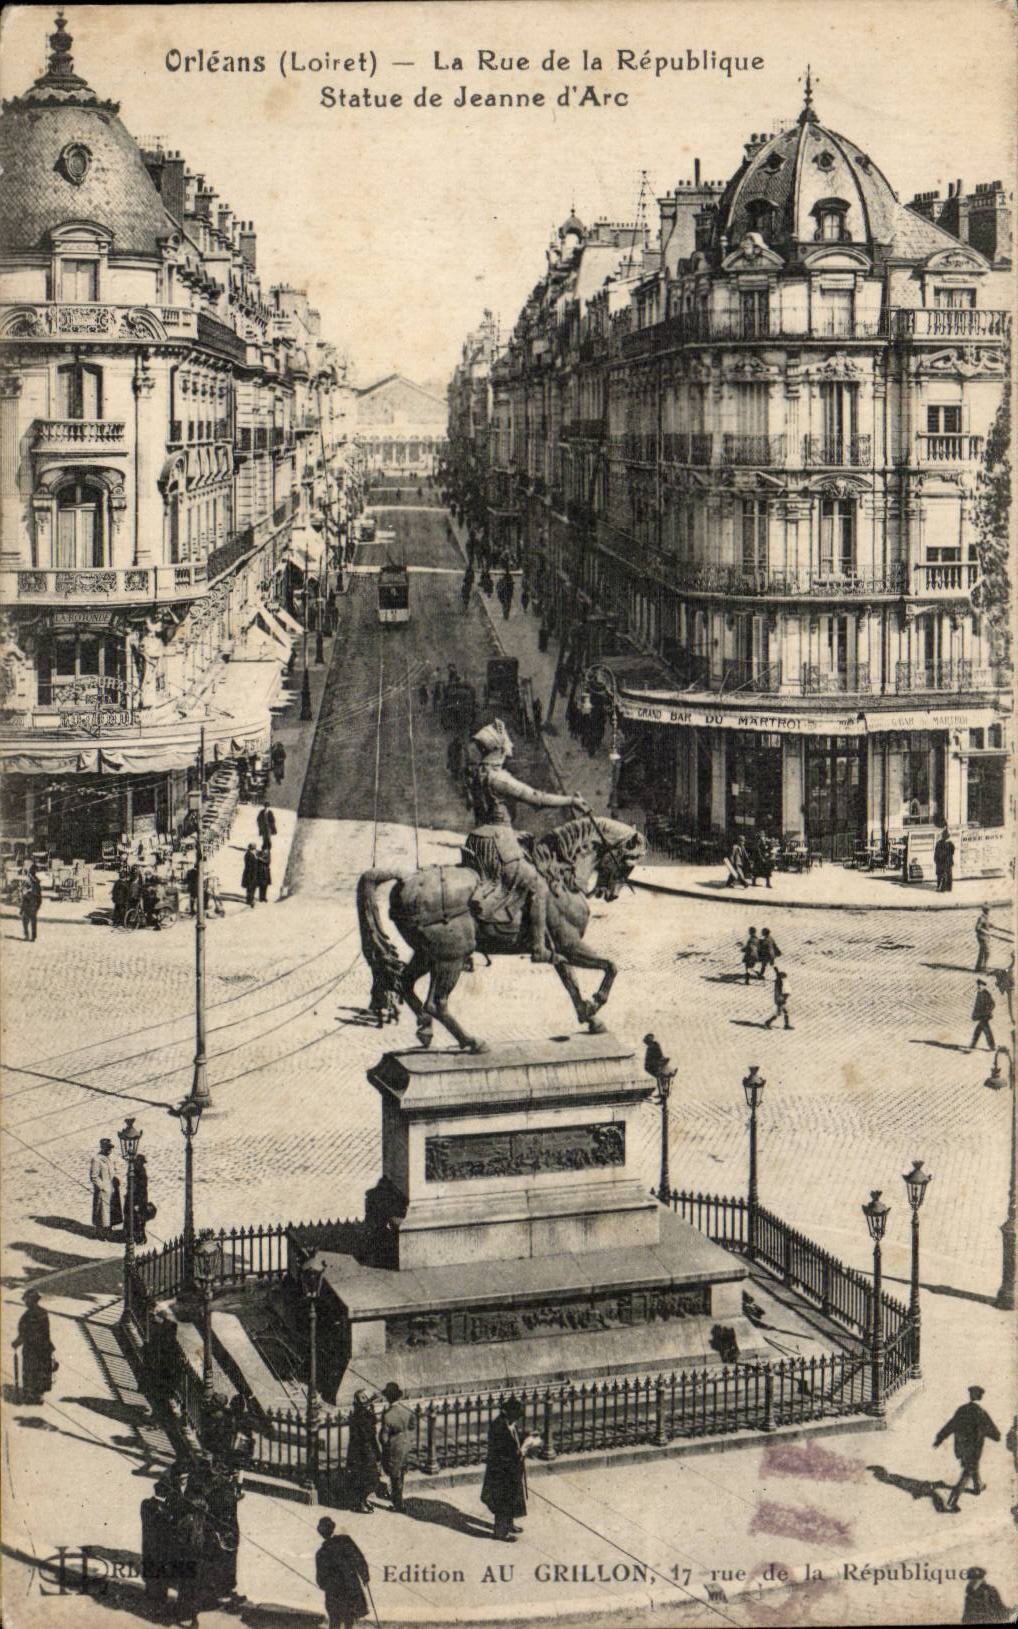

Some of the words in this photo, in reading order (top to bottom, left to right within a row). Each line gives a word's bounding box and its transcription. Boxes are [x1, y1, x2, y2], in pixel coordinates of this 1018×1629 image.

[670, 711, 692, 722] BAR
[705, 714, 724, 725] DU
[738, 716, 801, 730] MARTROI
